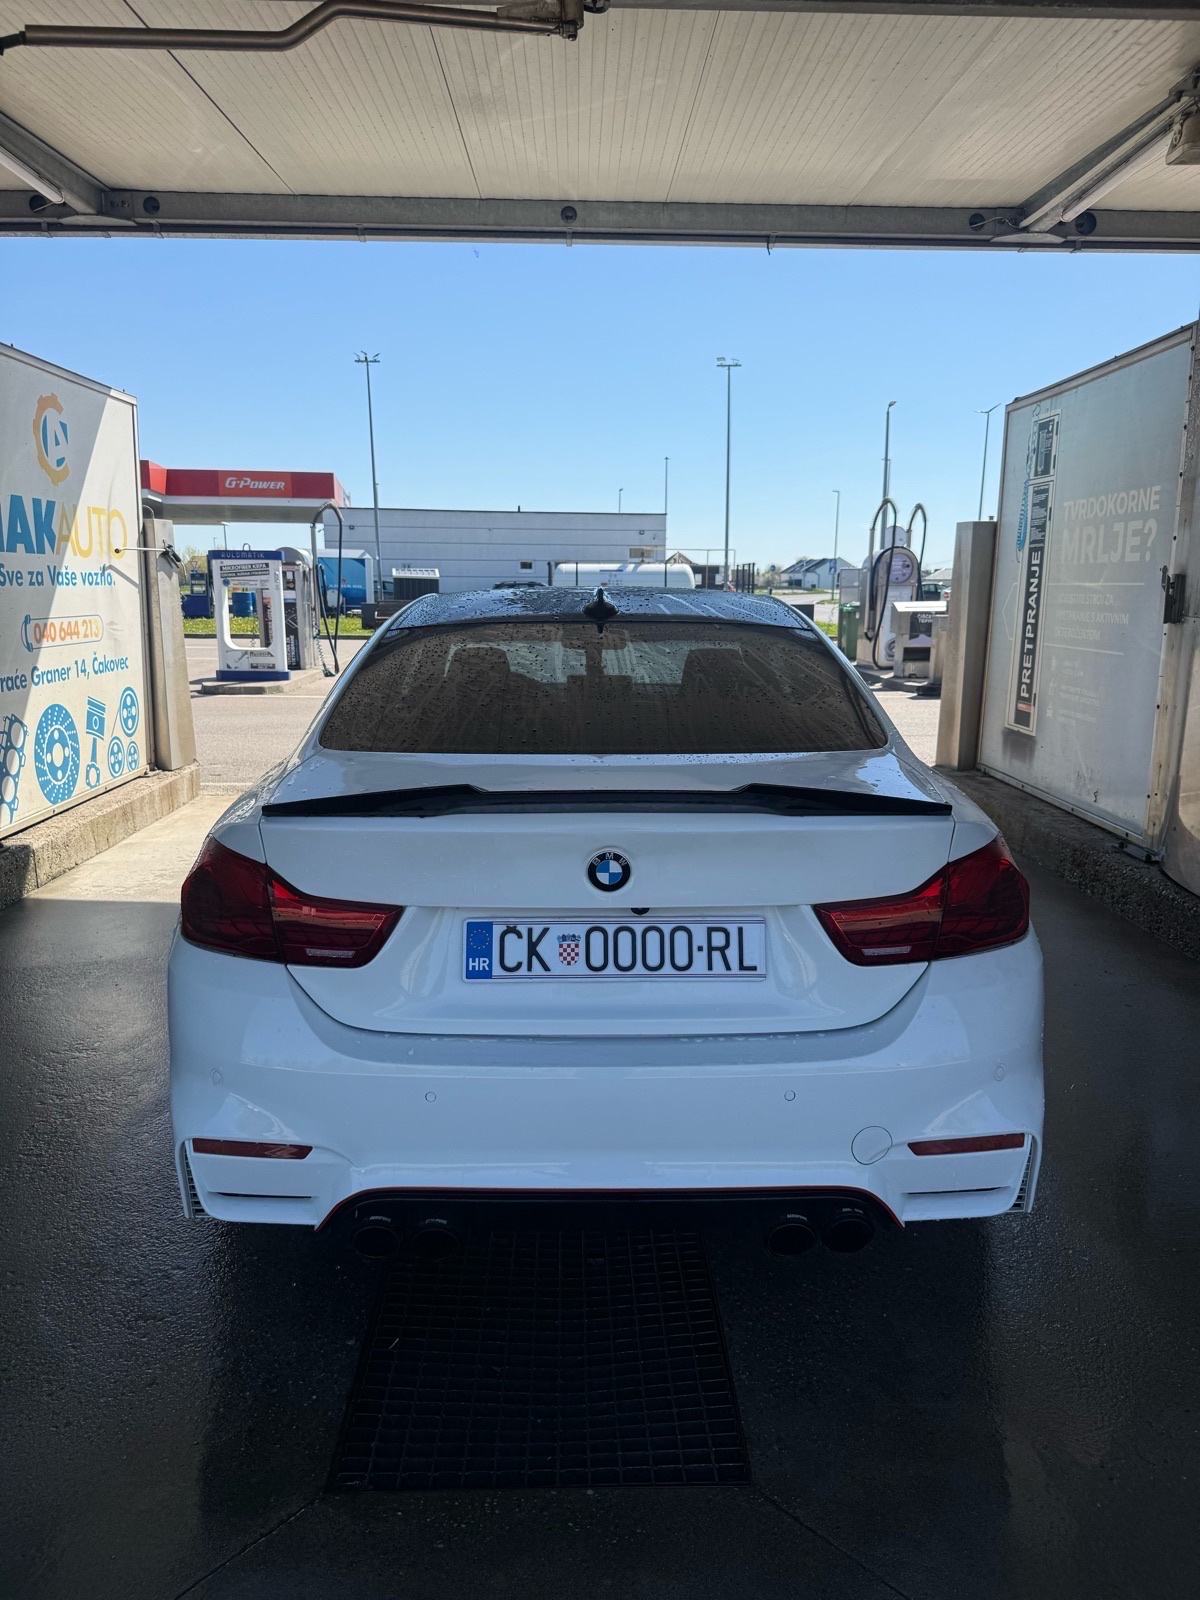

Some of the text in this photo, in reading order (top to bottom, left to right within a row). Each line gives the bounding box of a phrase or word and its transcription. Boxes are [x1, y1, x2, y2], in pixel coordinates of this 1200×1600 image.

[1063, 484, 1161, 521] TVRDOKORNE
[0, 495, 128, 560] AKAUTO
[1061, 517, 1158, 565] MRLJE?
[28, 571, 44, 586] za
[47, 565, 77, 586] Vaše
[33, 620, 100, 645] 040 644 213
[1020, 551, 1042, 698] PRETPRANJE
[0, 651, 129, 692] raće Graner 14, Čakovec
[468, 957, 490, 971] HR
[498, 925, 552, 973] ČK
